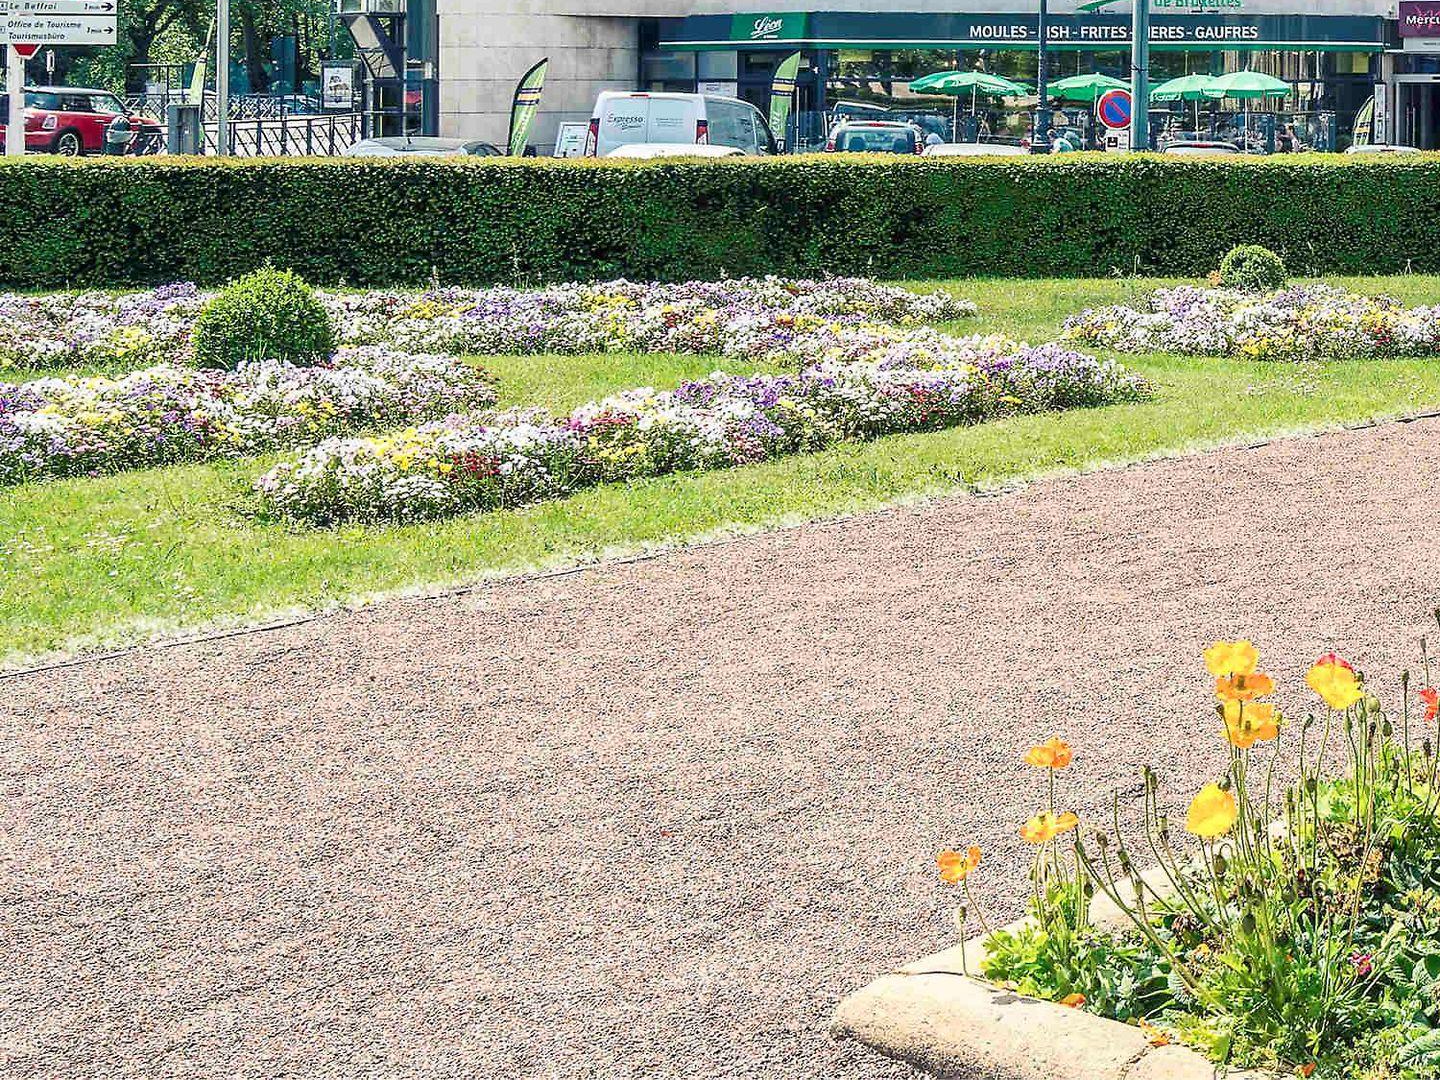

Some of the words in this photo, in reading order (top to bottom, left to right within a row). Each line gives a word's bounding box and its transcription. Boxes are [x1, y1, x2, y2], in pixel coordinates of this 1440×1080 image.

[24, 2, 57, 10] Beffroi
[47, 20, 81, 29] Tourisme
[969, 25, 1027, 40] MOULES
[1036, 25, 1070, 39] ISH
[1080, 25, 1128, 39] FRITES
[1147, 25, 1184, 39] IERES
[1195, 25, 1258, 39] GAUFRES
